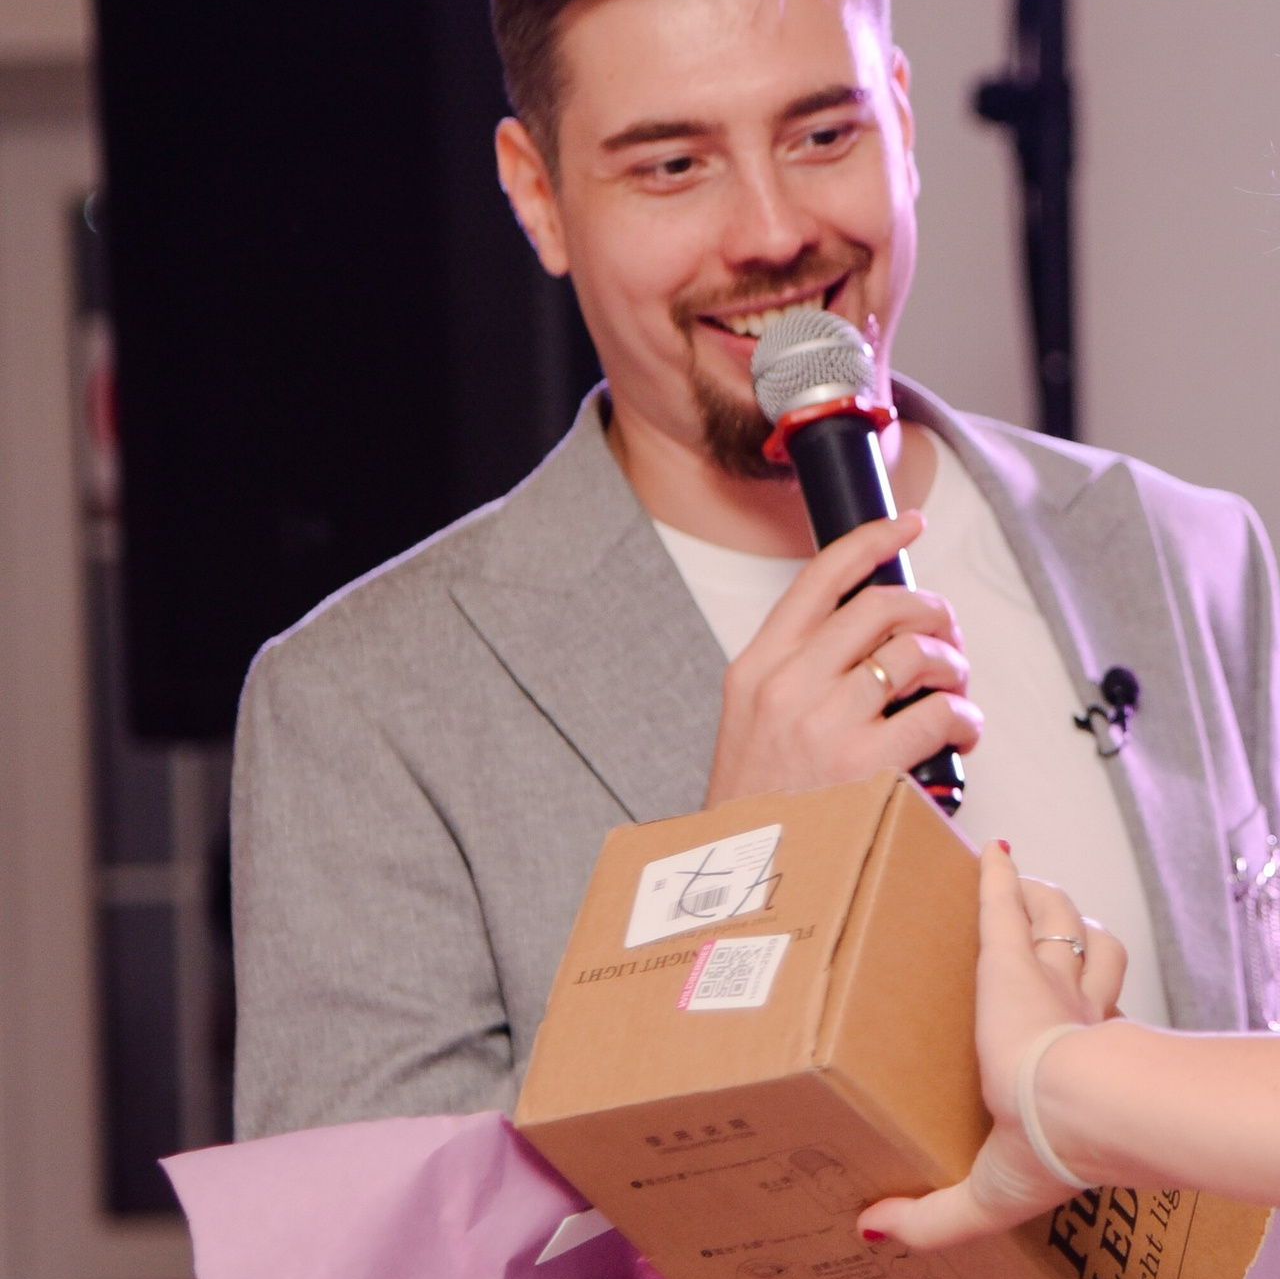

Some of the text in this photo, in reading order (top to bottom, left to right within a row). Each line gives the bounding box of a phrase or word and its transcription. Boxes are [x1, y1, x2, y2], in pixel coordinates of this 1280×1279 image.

[572, 960, 638, 985] LIGHT
[677, 943, 714, 1009] WILDBERRIES
[1150, 1188, 1182, 1232] lig
